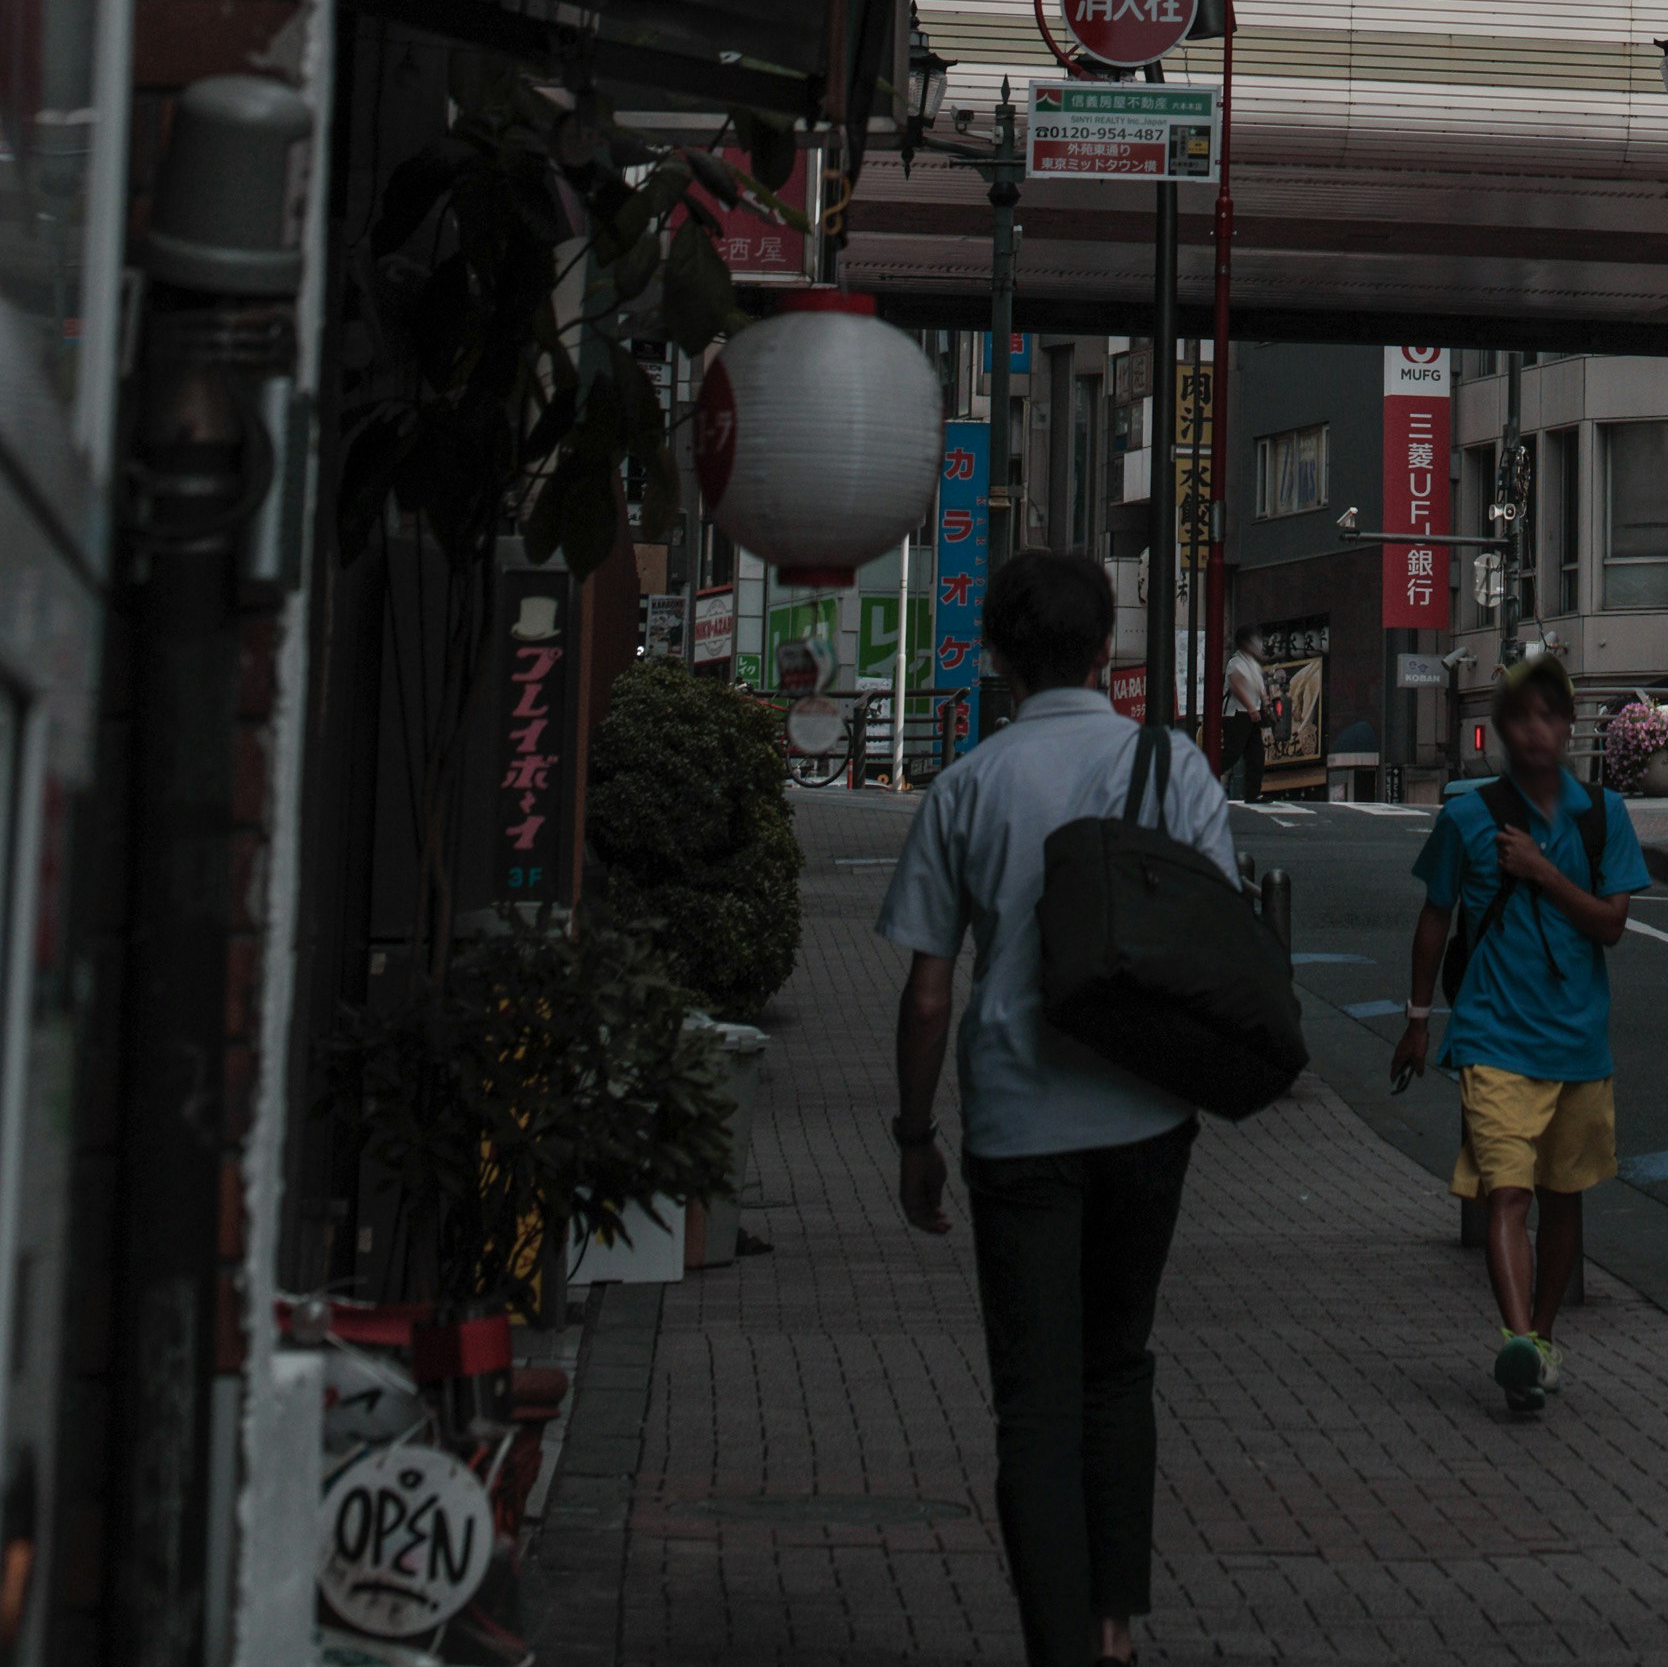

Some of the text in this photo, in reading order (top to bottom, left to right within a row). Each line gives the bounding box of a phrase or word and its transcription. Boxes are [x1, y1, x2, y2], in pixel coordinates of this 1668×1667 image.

[1071, 94, 1169, 111] 信義房屋不動産
[1095, 116, 1125, 125] REALTY
[1050, 126, 1164, 141] 0120-954-487
[1067, 143, 1131, 156] 外苑東通り
[1041, 157, 1157, 173] 東京ミッドタウン横
[1401, 369, 1441, 382] MUFG
[1407, 413, 1434, 606] 三菱UFJ銀行
[1405, 673, 1440, 683] KOBAN
[501, 646, 563, 850] プレイボーイ
[506, 866, 543, 889] 3F
[336, 1487, 474, 1585] OPEN
